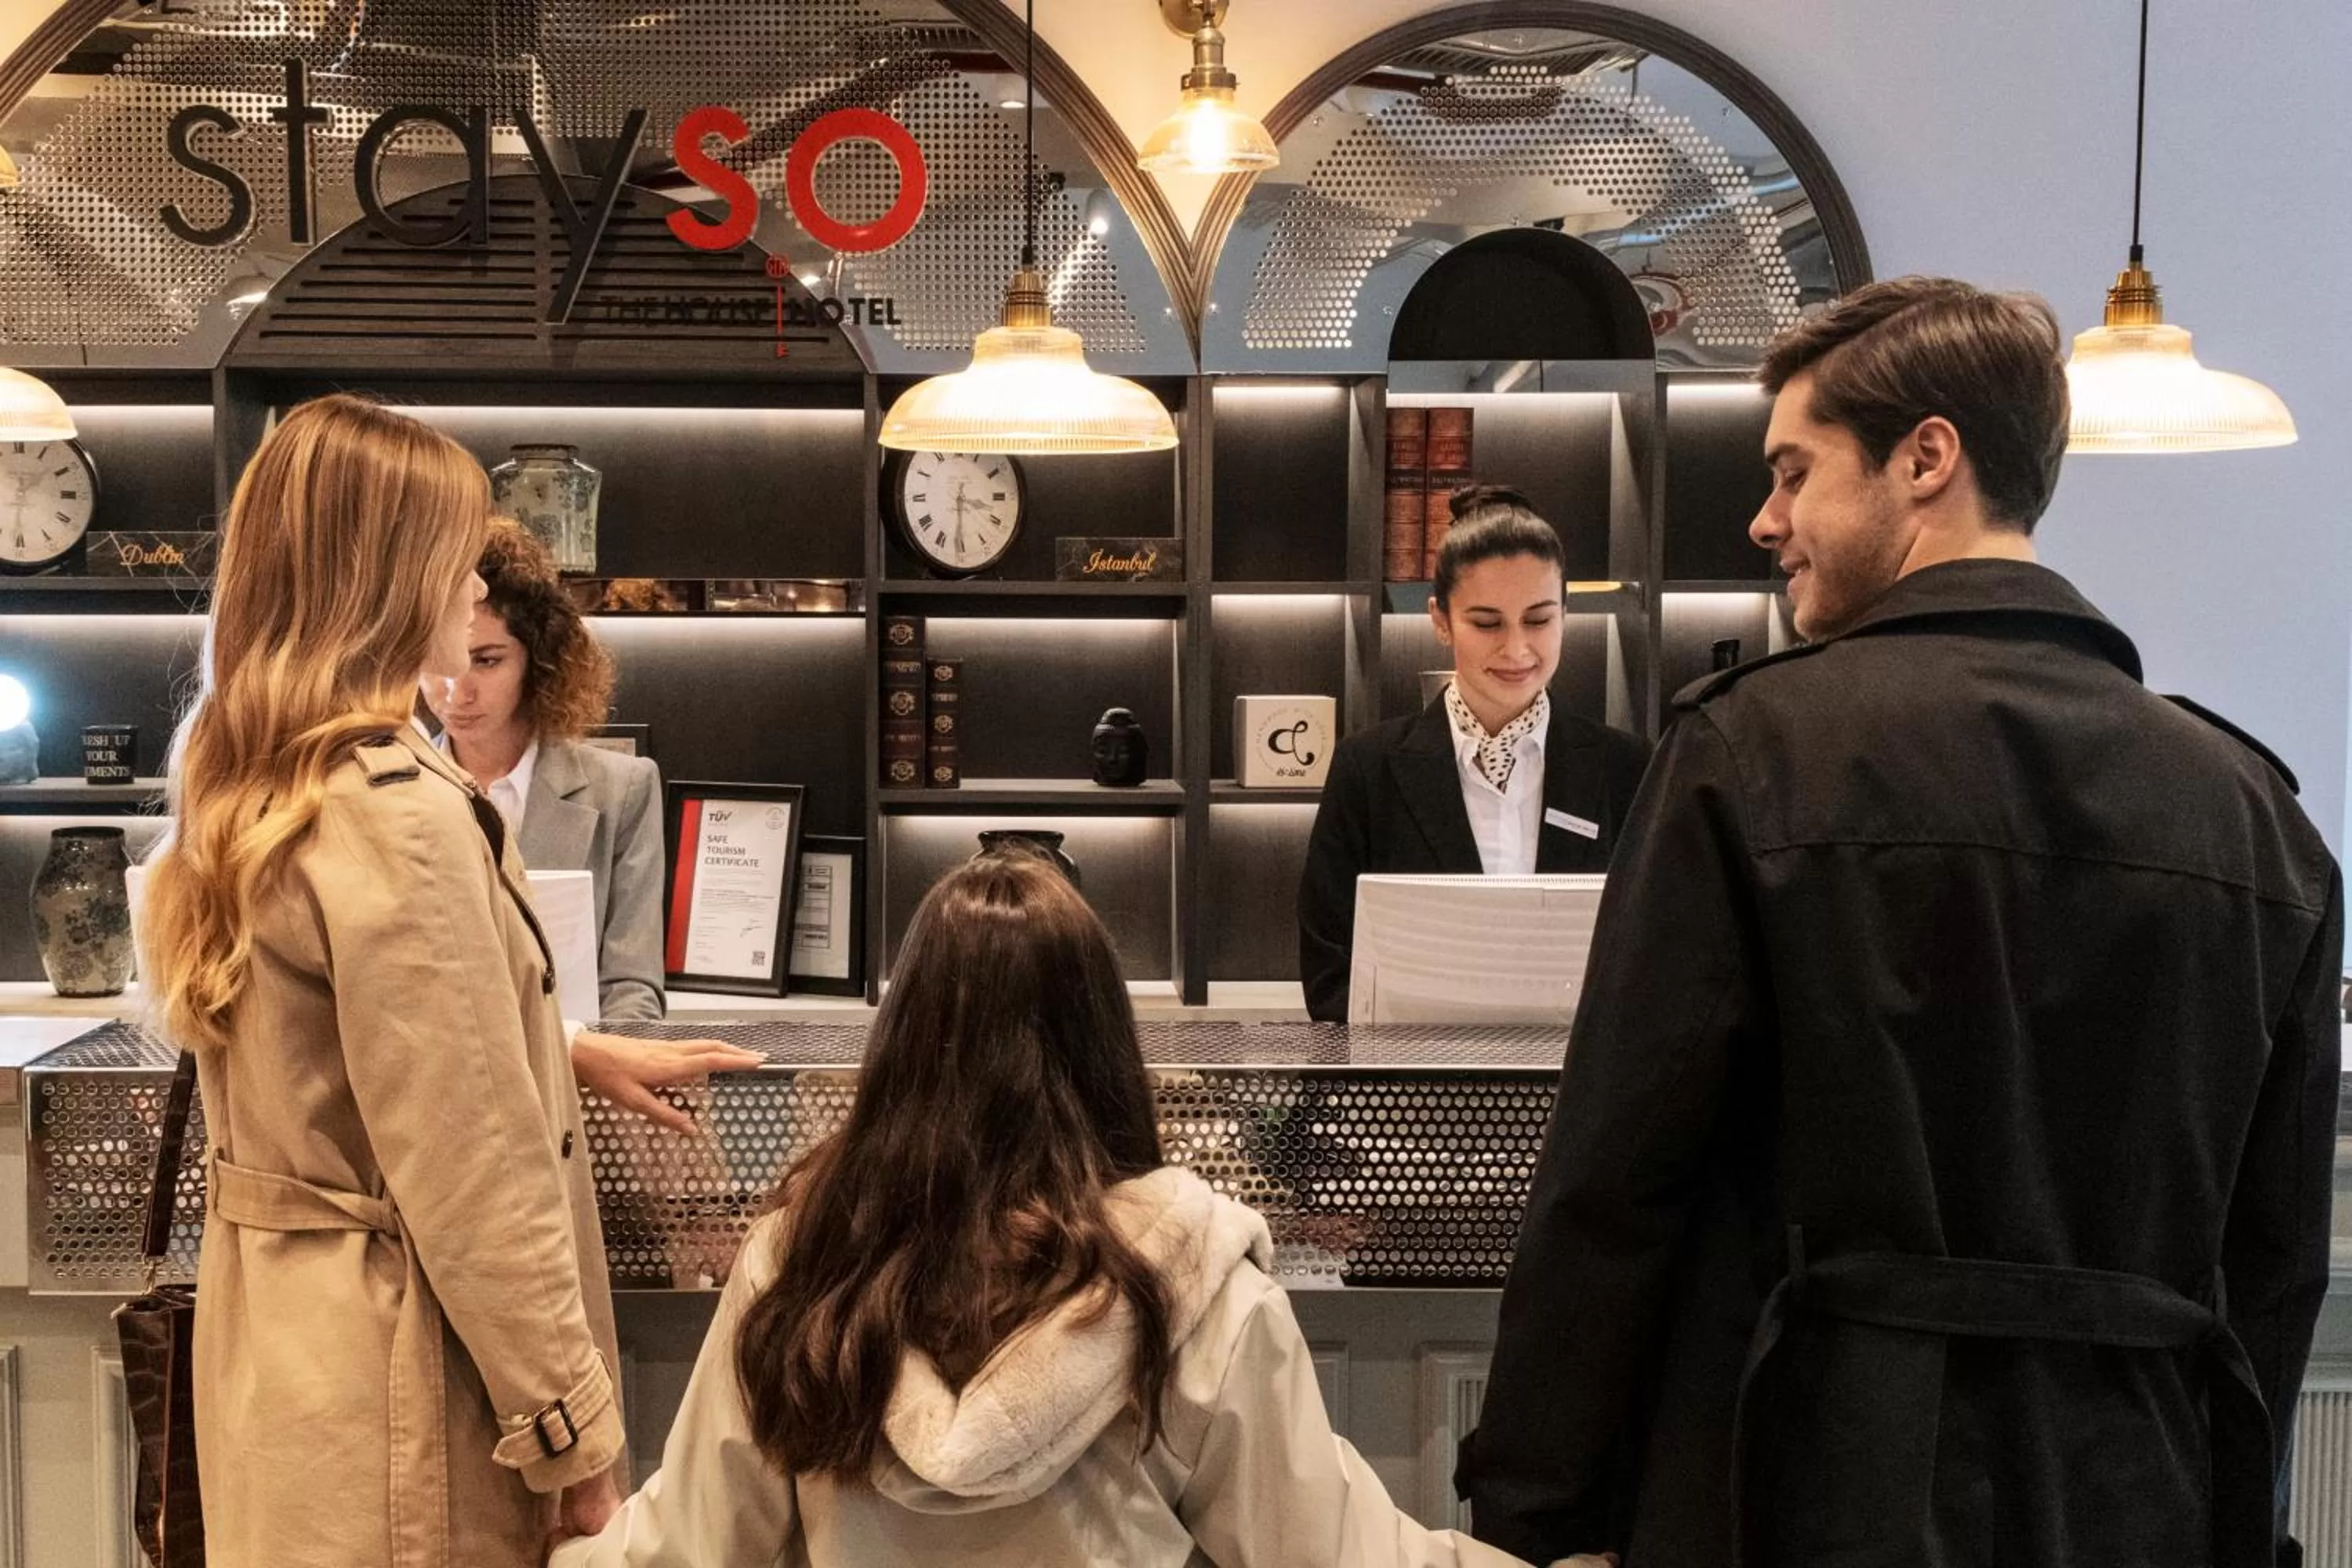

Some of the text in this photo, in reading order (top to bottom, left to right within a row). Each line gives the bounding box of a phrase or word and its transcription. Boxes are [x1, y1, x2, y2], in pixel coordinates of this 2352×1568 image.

[600, 296, 659, 326] THE
[789, 296, 902, 326] HOTEL
[120, 543, 185, 565] Dublin
[1082, 549, 1156, 573] Istanbul
[85, 750, 118, 762] YOUR
[709, 811, 732, 822] TÜV
[707, 834, 728, 844] SAFE
[706, 846, 746, 855] TOURISM
[705, 856, 760, 867] CERTIFICATE
